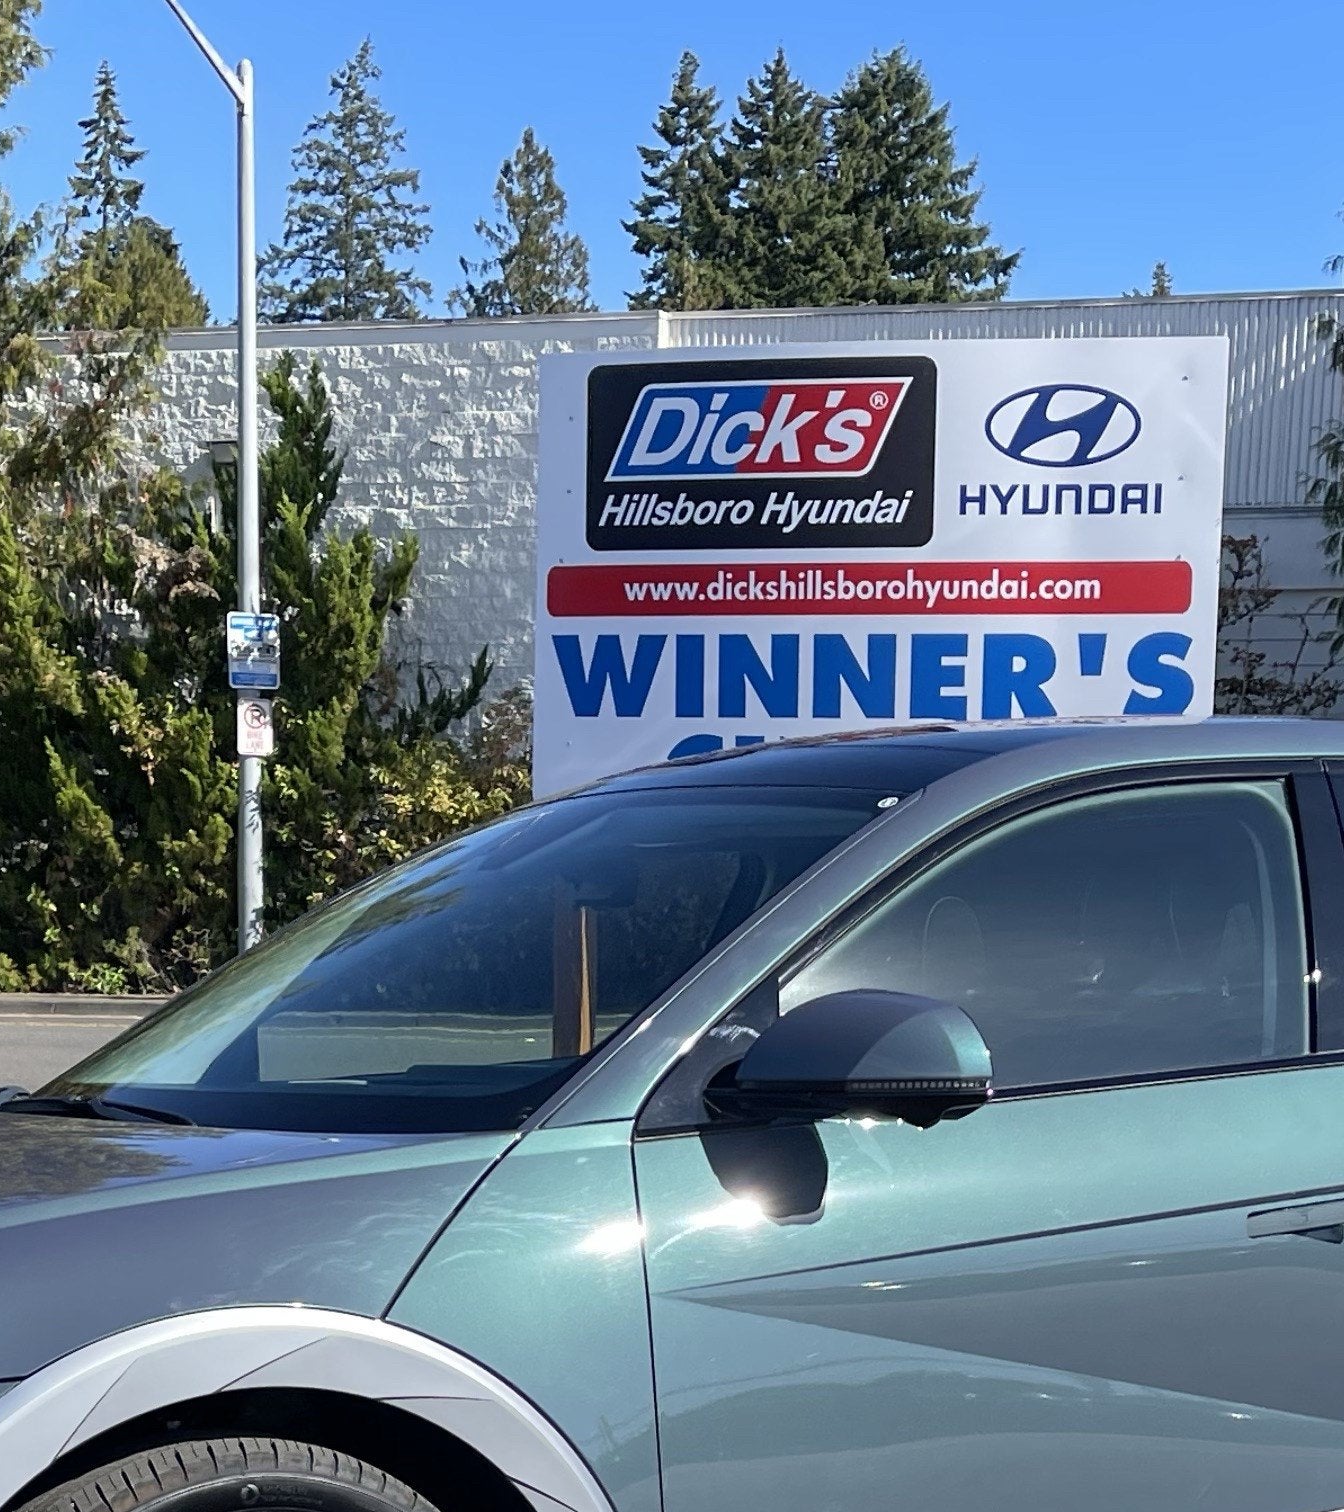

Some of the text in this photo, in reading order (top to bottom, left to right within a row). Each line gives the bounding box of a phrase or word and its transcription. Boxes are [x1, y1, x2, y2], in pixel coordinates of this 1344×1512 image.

[599, 490, 913, 533] Hillsboro Hyundai
[960, 482, 1162, 515] HYUNDAI
[623, 568, 1101, 608] www.dickshillsborohyundai.com
[552, 631, 1194, 720] WINNER'S
